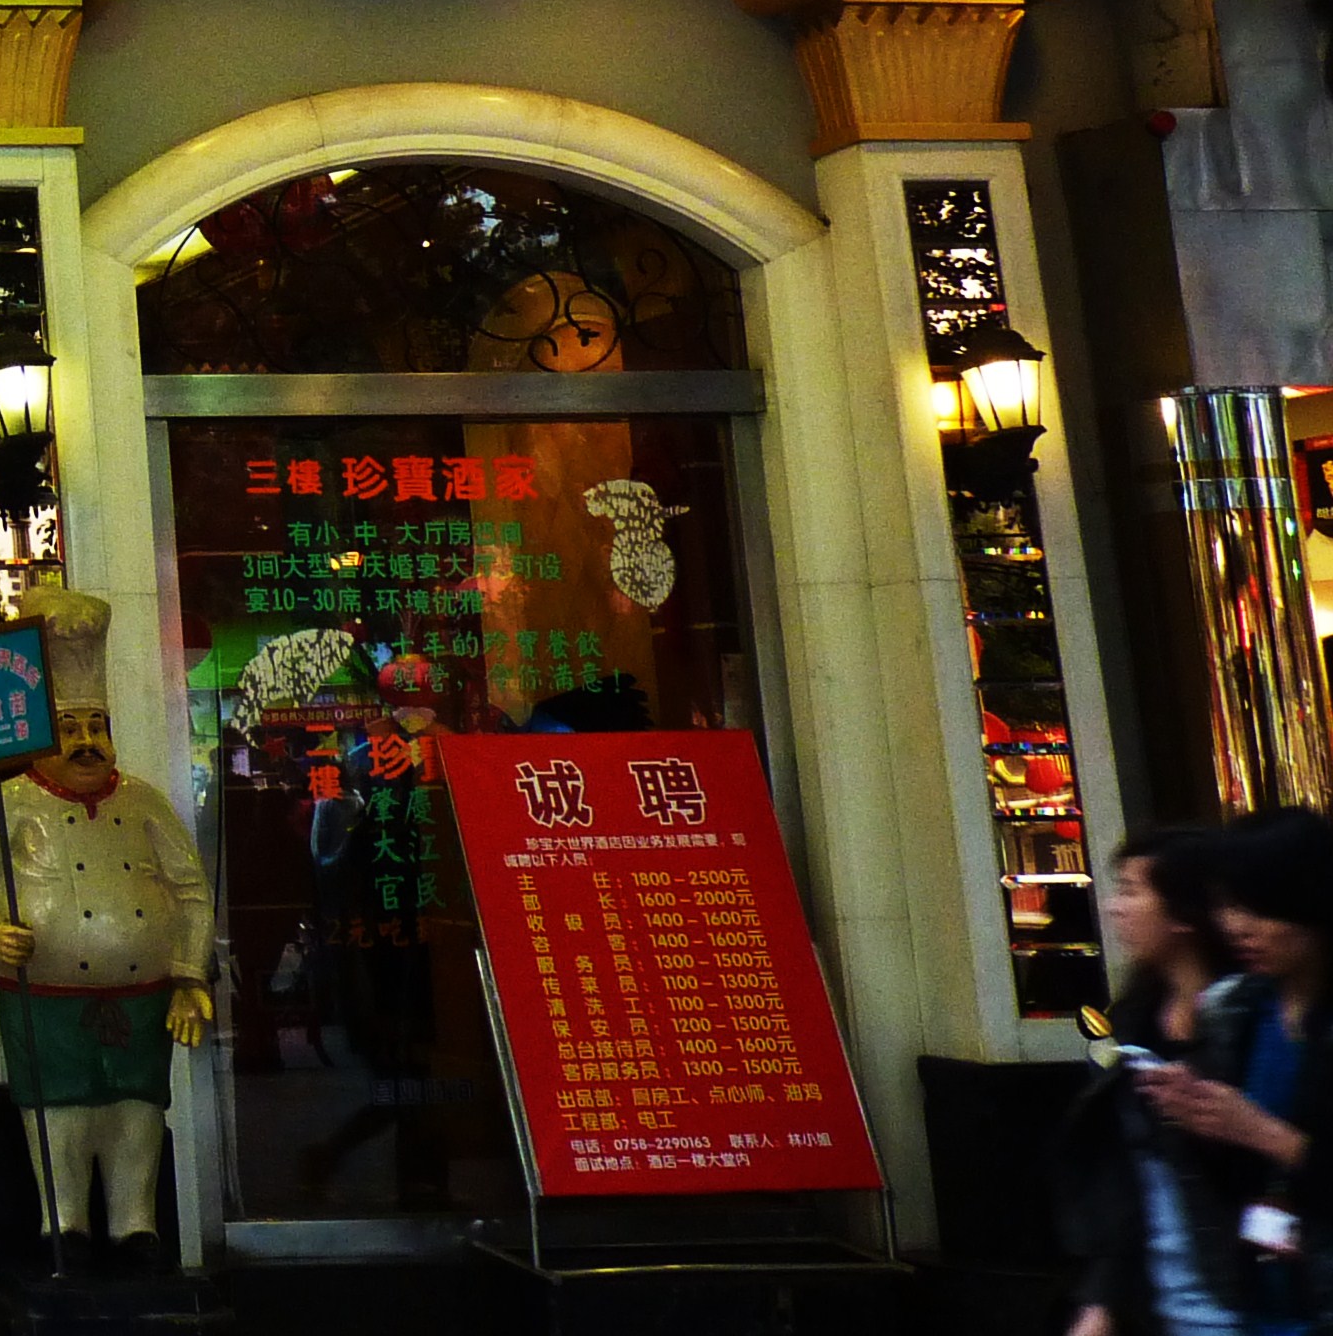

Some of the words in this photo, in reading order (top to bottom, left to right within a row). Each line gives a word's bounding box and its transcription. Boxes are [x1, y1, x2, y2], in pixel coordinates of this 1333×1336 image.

[246, 459, 323, 495] 三樓
[341, 455, 538, 502] 珍寶酒家
[516, 758, 707, 828] 诚聘
